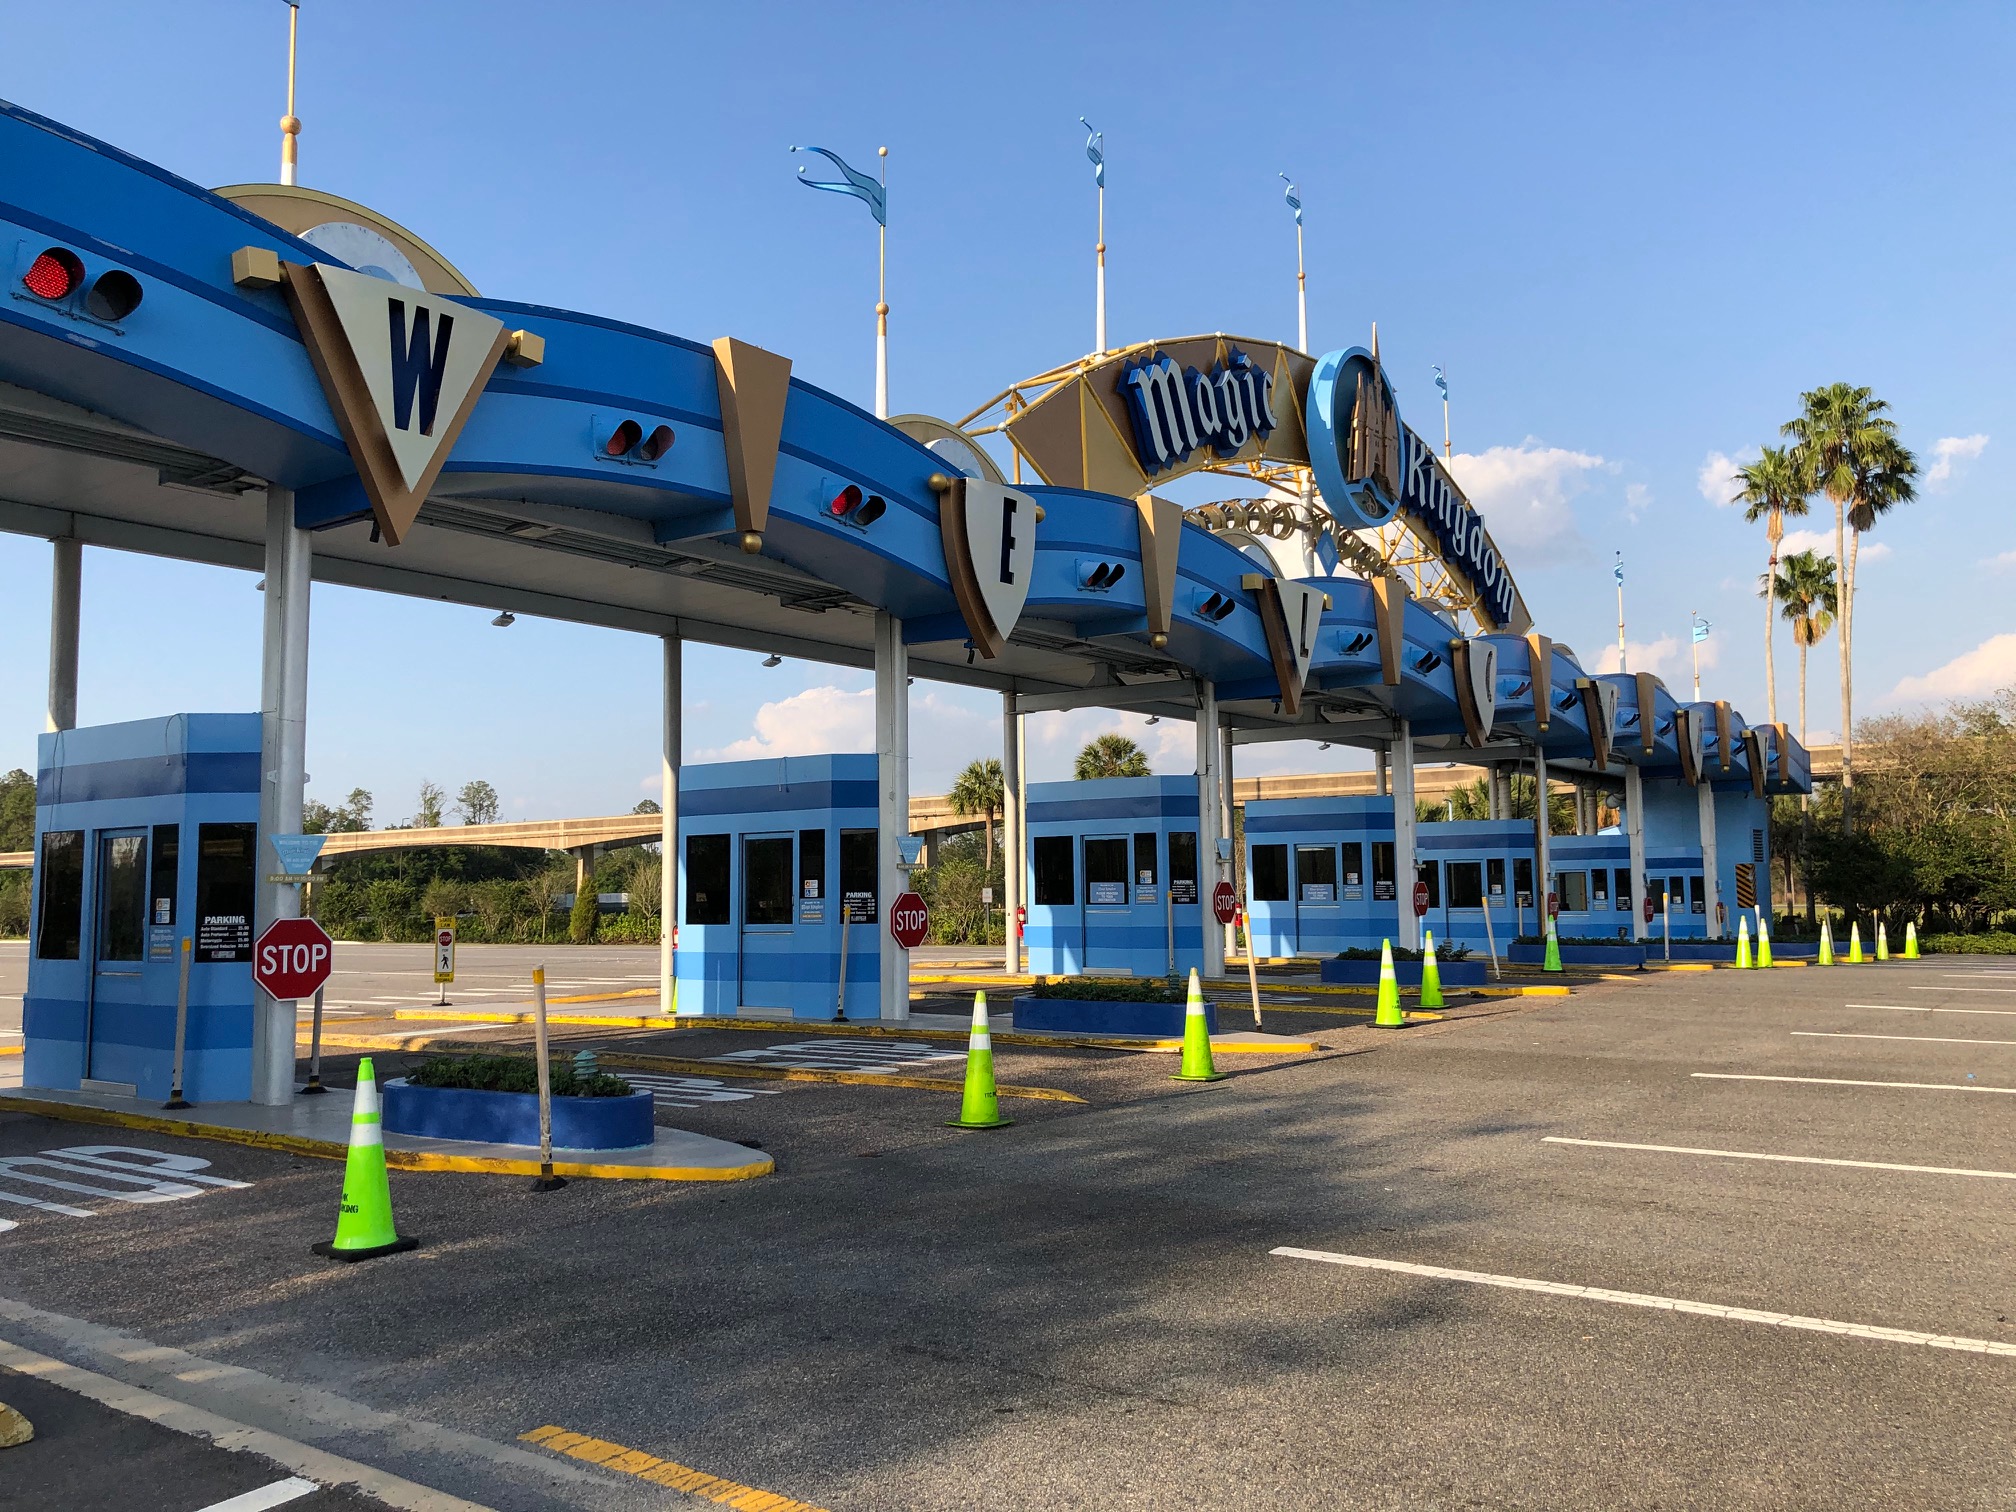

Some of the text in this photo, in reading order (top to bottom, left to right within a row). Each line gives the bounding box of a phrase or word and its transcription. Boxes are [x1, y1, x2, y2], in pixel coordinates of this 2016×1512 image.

[1123, 349, 1279, 468] Magic
[387, 297, 454, 438] W
[1000, 496, 1017, 585] E
[1300, 592, 1309, 658] L
[1406, 432, 1516, 625] Kingdom
[1217, 894, 1234, 911] STOP
[1416, 892, 1428, 906] STOP
[204, 915, 246, 924] PARKING
[896, 909, 926, 931] STOP
[261, 943, 328, 976] STOP
